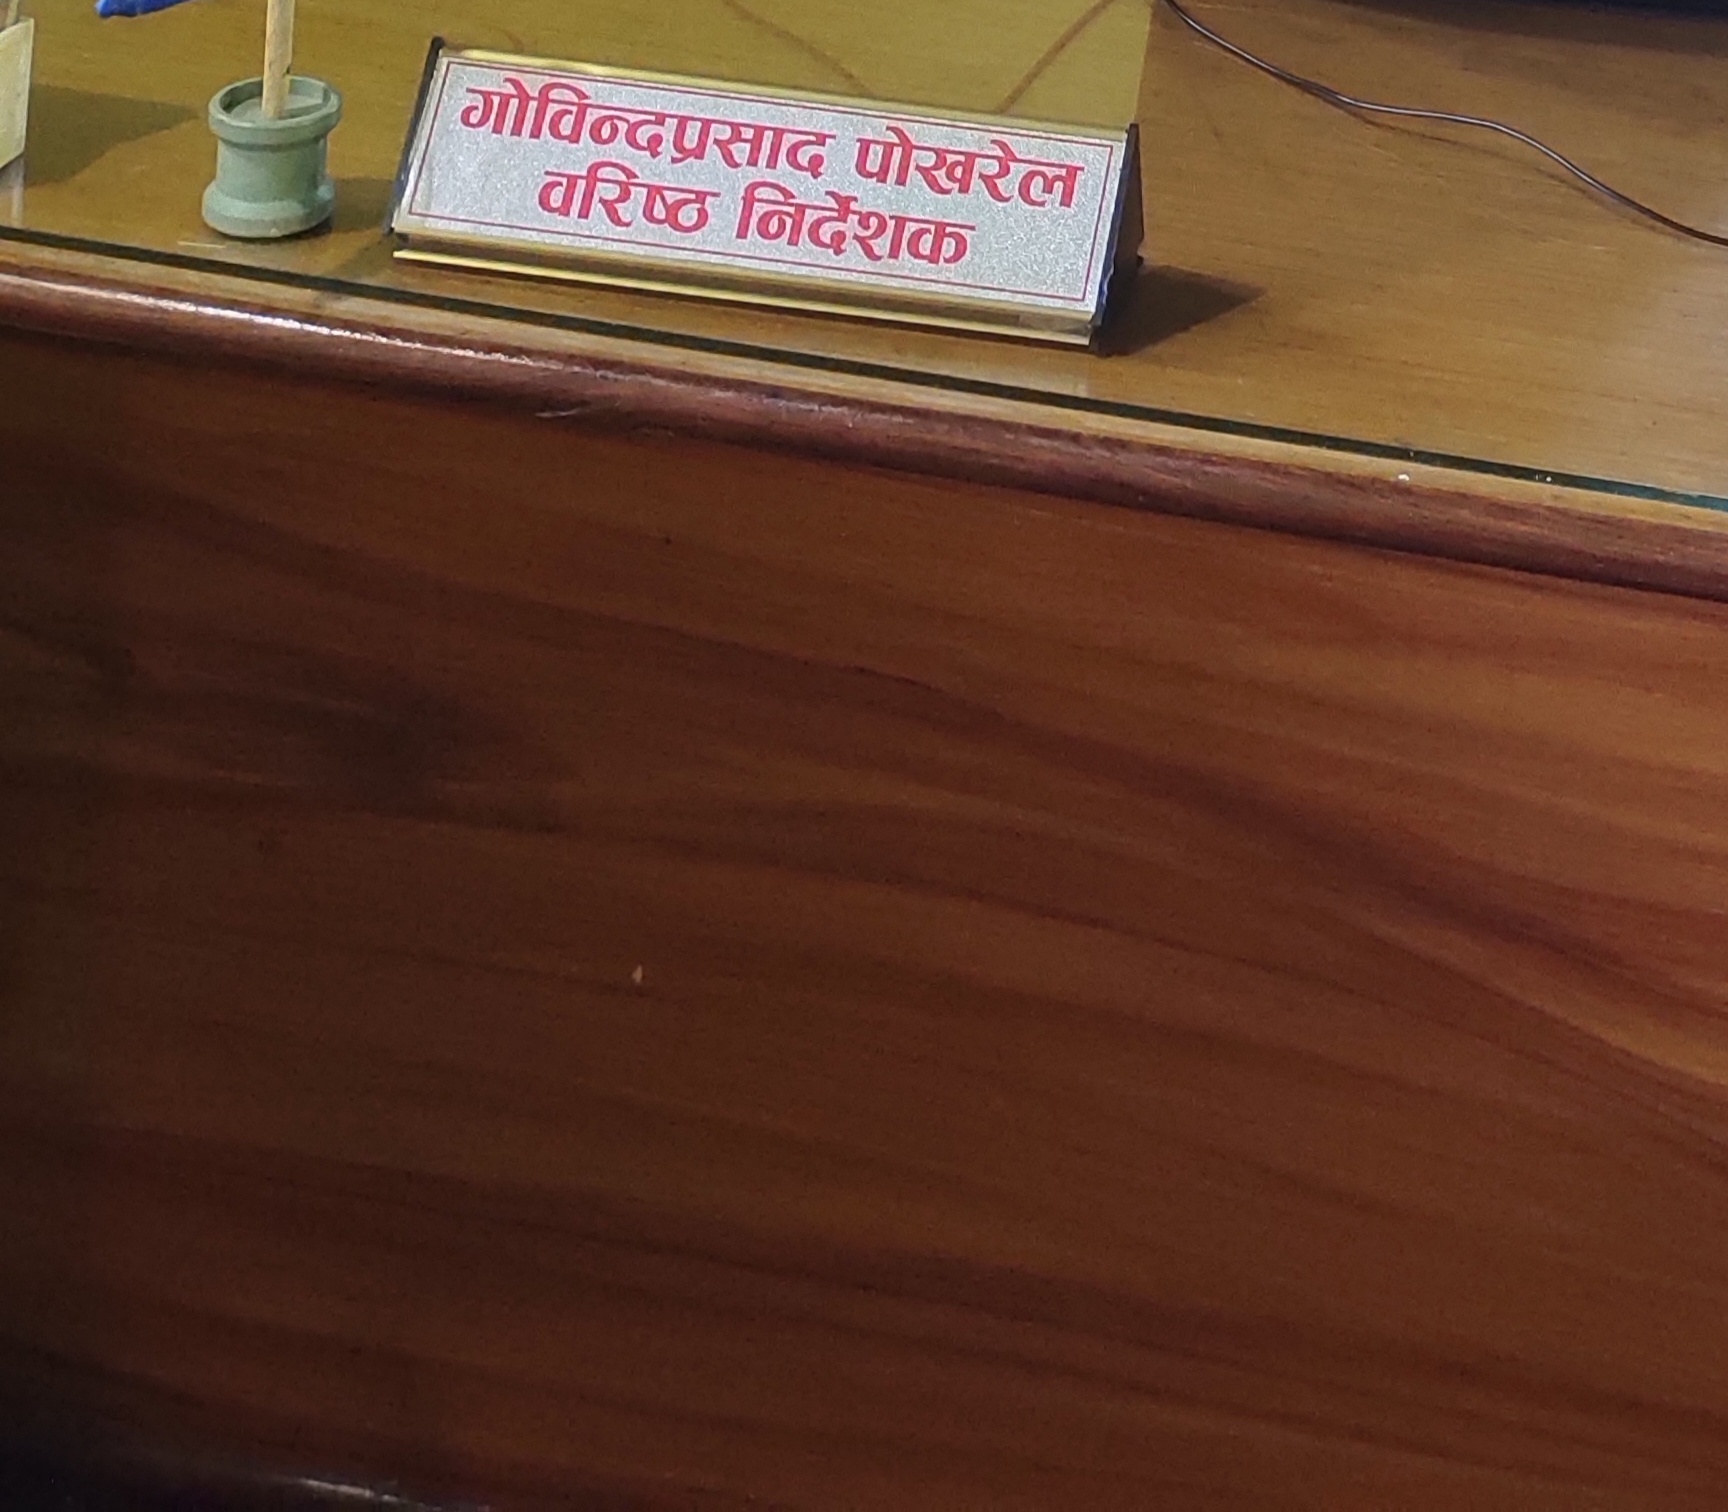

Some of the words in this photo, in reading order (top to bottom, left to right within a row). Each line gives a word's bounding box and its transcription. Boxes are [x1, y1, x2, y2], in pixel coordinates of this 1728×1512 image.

[460, 77, 836, 179] गोविन्दप्रसाद
[856, 125, 1084, 210] पोखरेल
[537, 161, 721, 233] वरिष्ठ
[735, 180, 977, 267] निर्देशक
